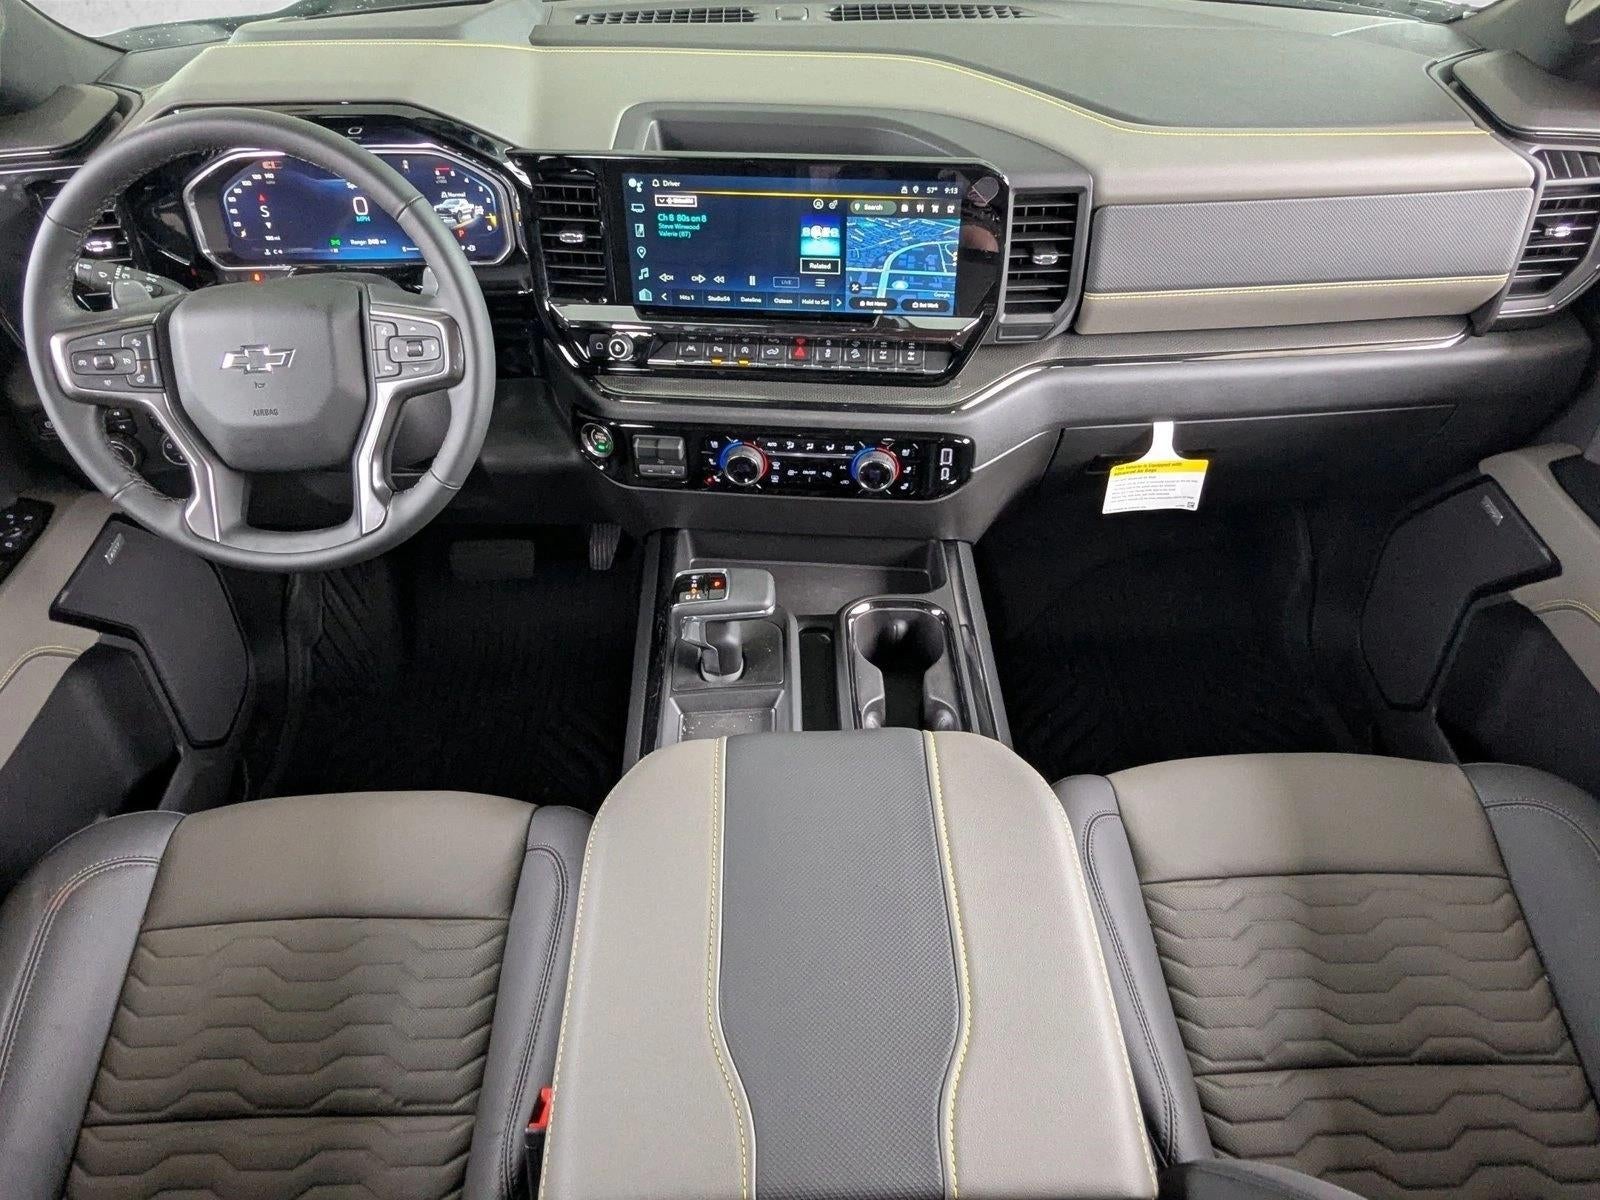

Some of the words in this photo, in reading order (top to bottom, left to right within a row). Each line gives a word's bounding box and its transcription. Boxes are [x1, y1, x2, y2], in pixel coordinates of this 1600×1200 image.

[926, 186, 938, 194] 57°
[352, 196, 369, 216] 0
[260, 205, 270, 218] S
[657, 213, 668, 222] Ch
[669, 214, 675, 222] 8
[676, 214, 690, 222] 80s
[701, 214, 707, 223] 8
[674, 223, 700, 231] Winwood
[809, 262, 831, 270] Related
[933, 291, 950, 299] Google
[253, 408, 279, 417] AIRBAG
